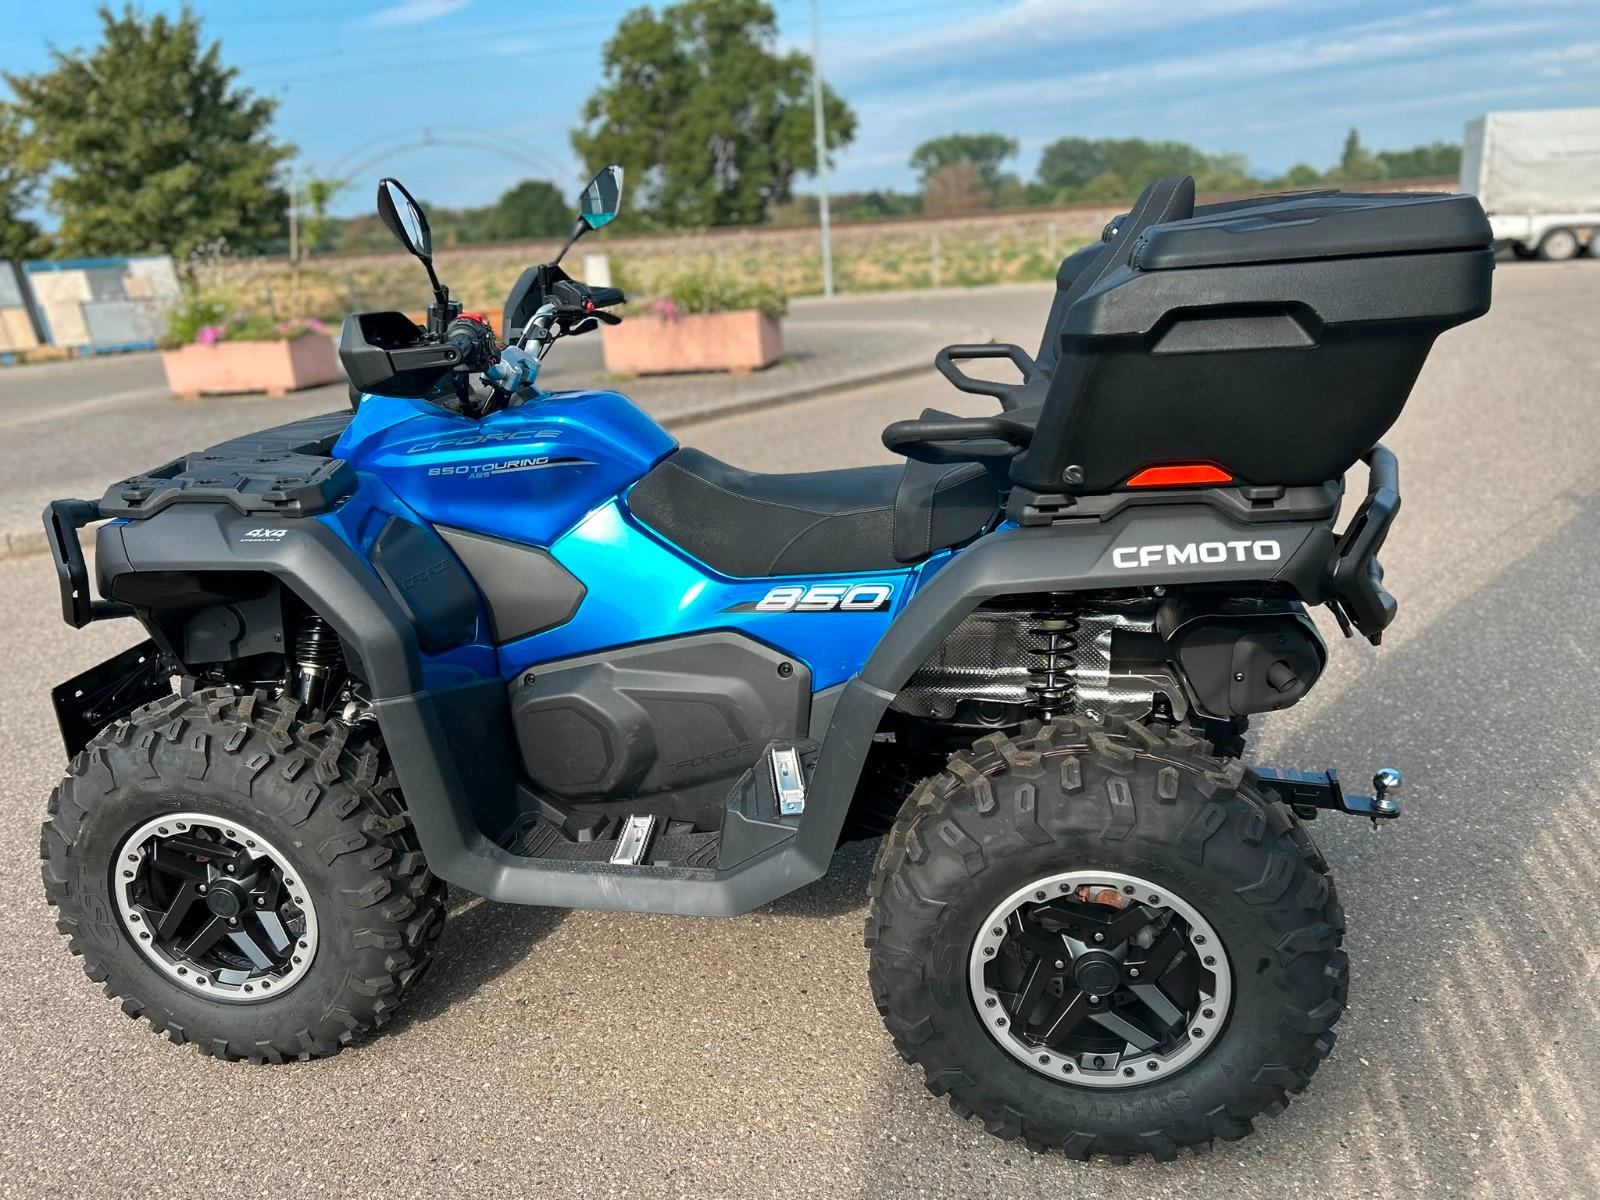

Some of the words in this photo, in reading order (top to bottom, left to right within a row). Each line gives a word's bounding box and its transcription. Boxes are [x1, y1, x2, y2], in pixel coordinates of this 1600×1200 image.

[407, 429, 563, 455] CFORCE
[468, 471, 490, 481] ABS
[1112, 539, 1281, 569] CFMOTO
[755, 582, 895, 611] 850
